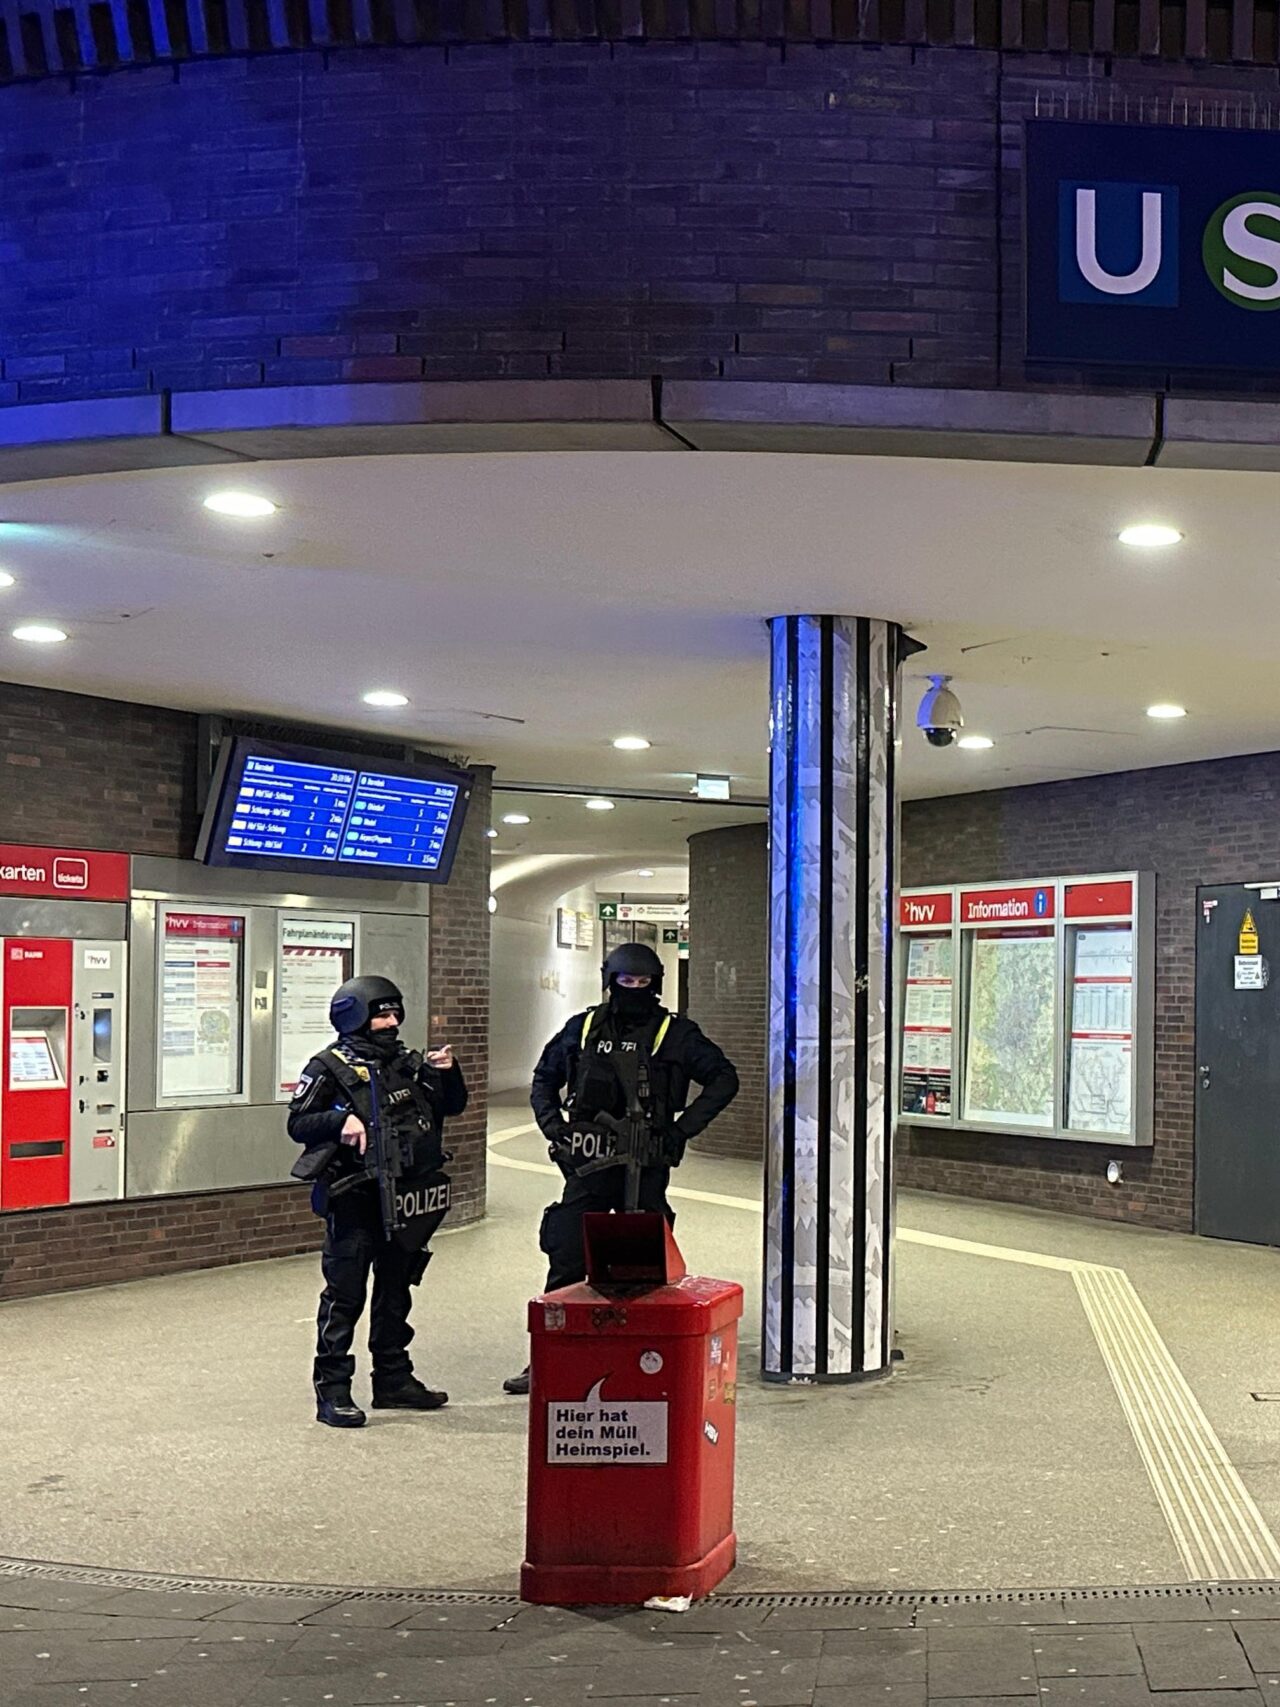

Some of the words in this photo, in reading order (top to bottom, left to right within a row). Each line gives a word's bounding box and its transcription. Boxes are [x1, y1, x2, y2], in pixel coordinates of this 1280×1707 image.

[1075, 188, 1162, 295] U
[909, 900, 936, 922] hvv
[967, 897, 1029, 920] Information
[168, 917, 189, 930] hvv
[395, 1184, 451, 1218] POLIZEI
[556, 1409, 594, 1423] Hier
[600, 1409, 629, 1422] hat
[555, 1426, 594, 1439] dein
[600, 1426, 638, 1439] Müll
[555, 1443, 651, 1459] Heimspiel.
